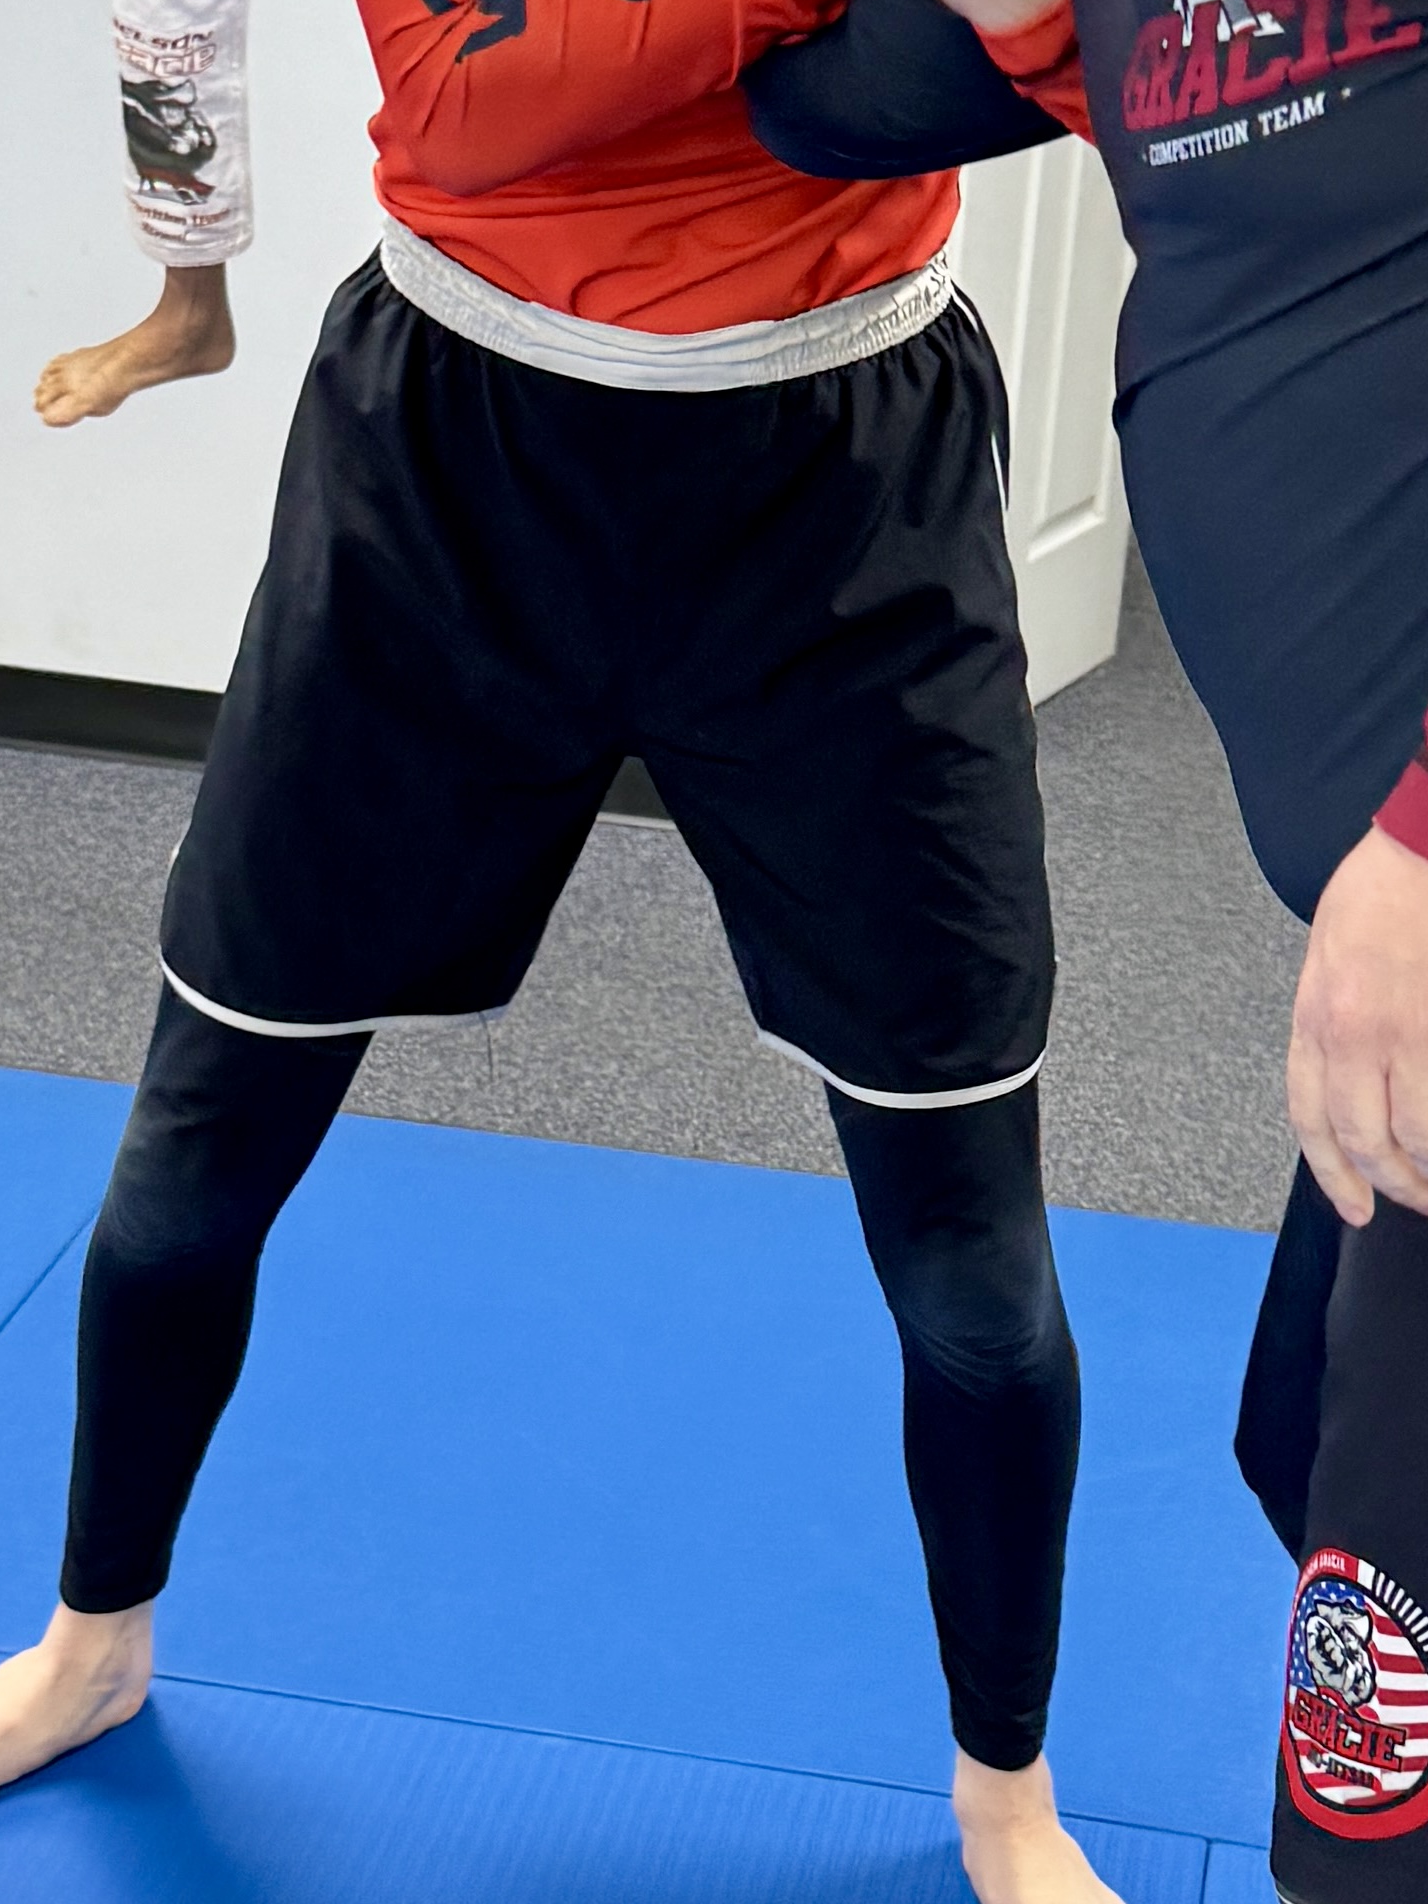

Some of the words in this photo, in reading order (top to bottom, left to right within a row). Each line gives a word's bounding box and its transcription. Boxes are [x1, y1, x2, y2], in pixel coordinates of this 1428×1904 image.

[1149, 120, 1250, 166] COMPETITION
[1258, 91, 1326, 136] TEAM
[1293, 1688, 1406, 1772] GRACIE
